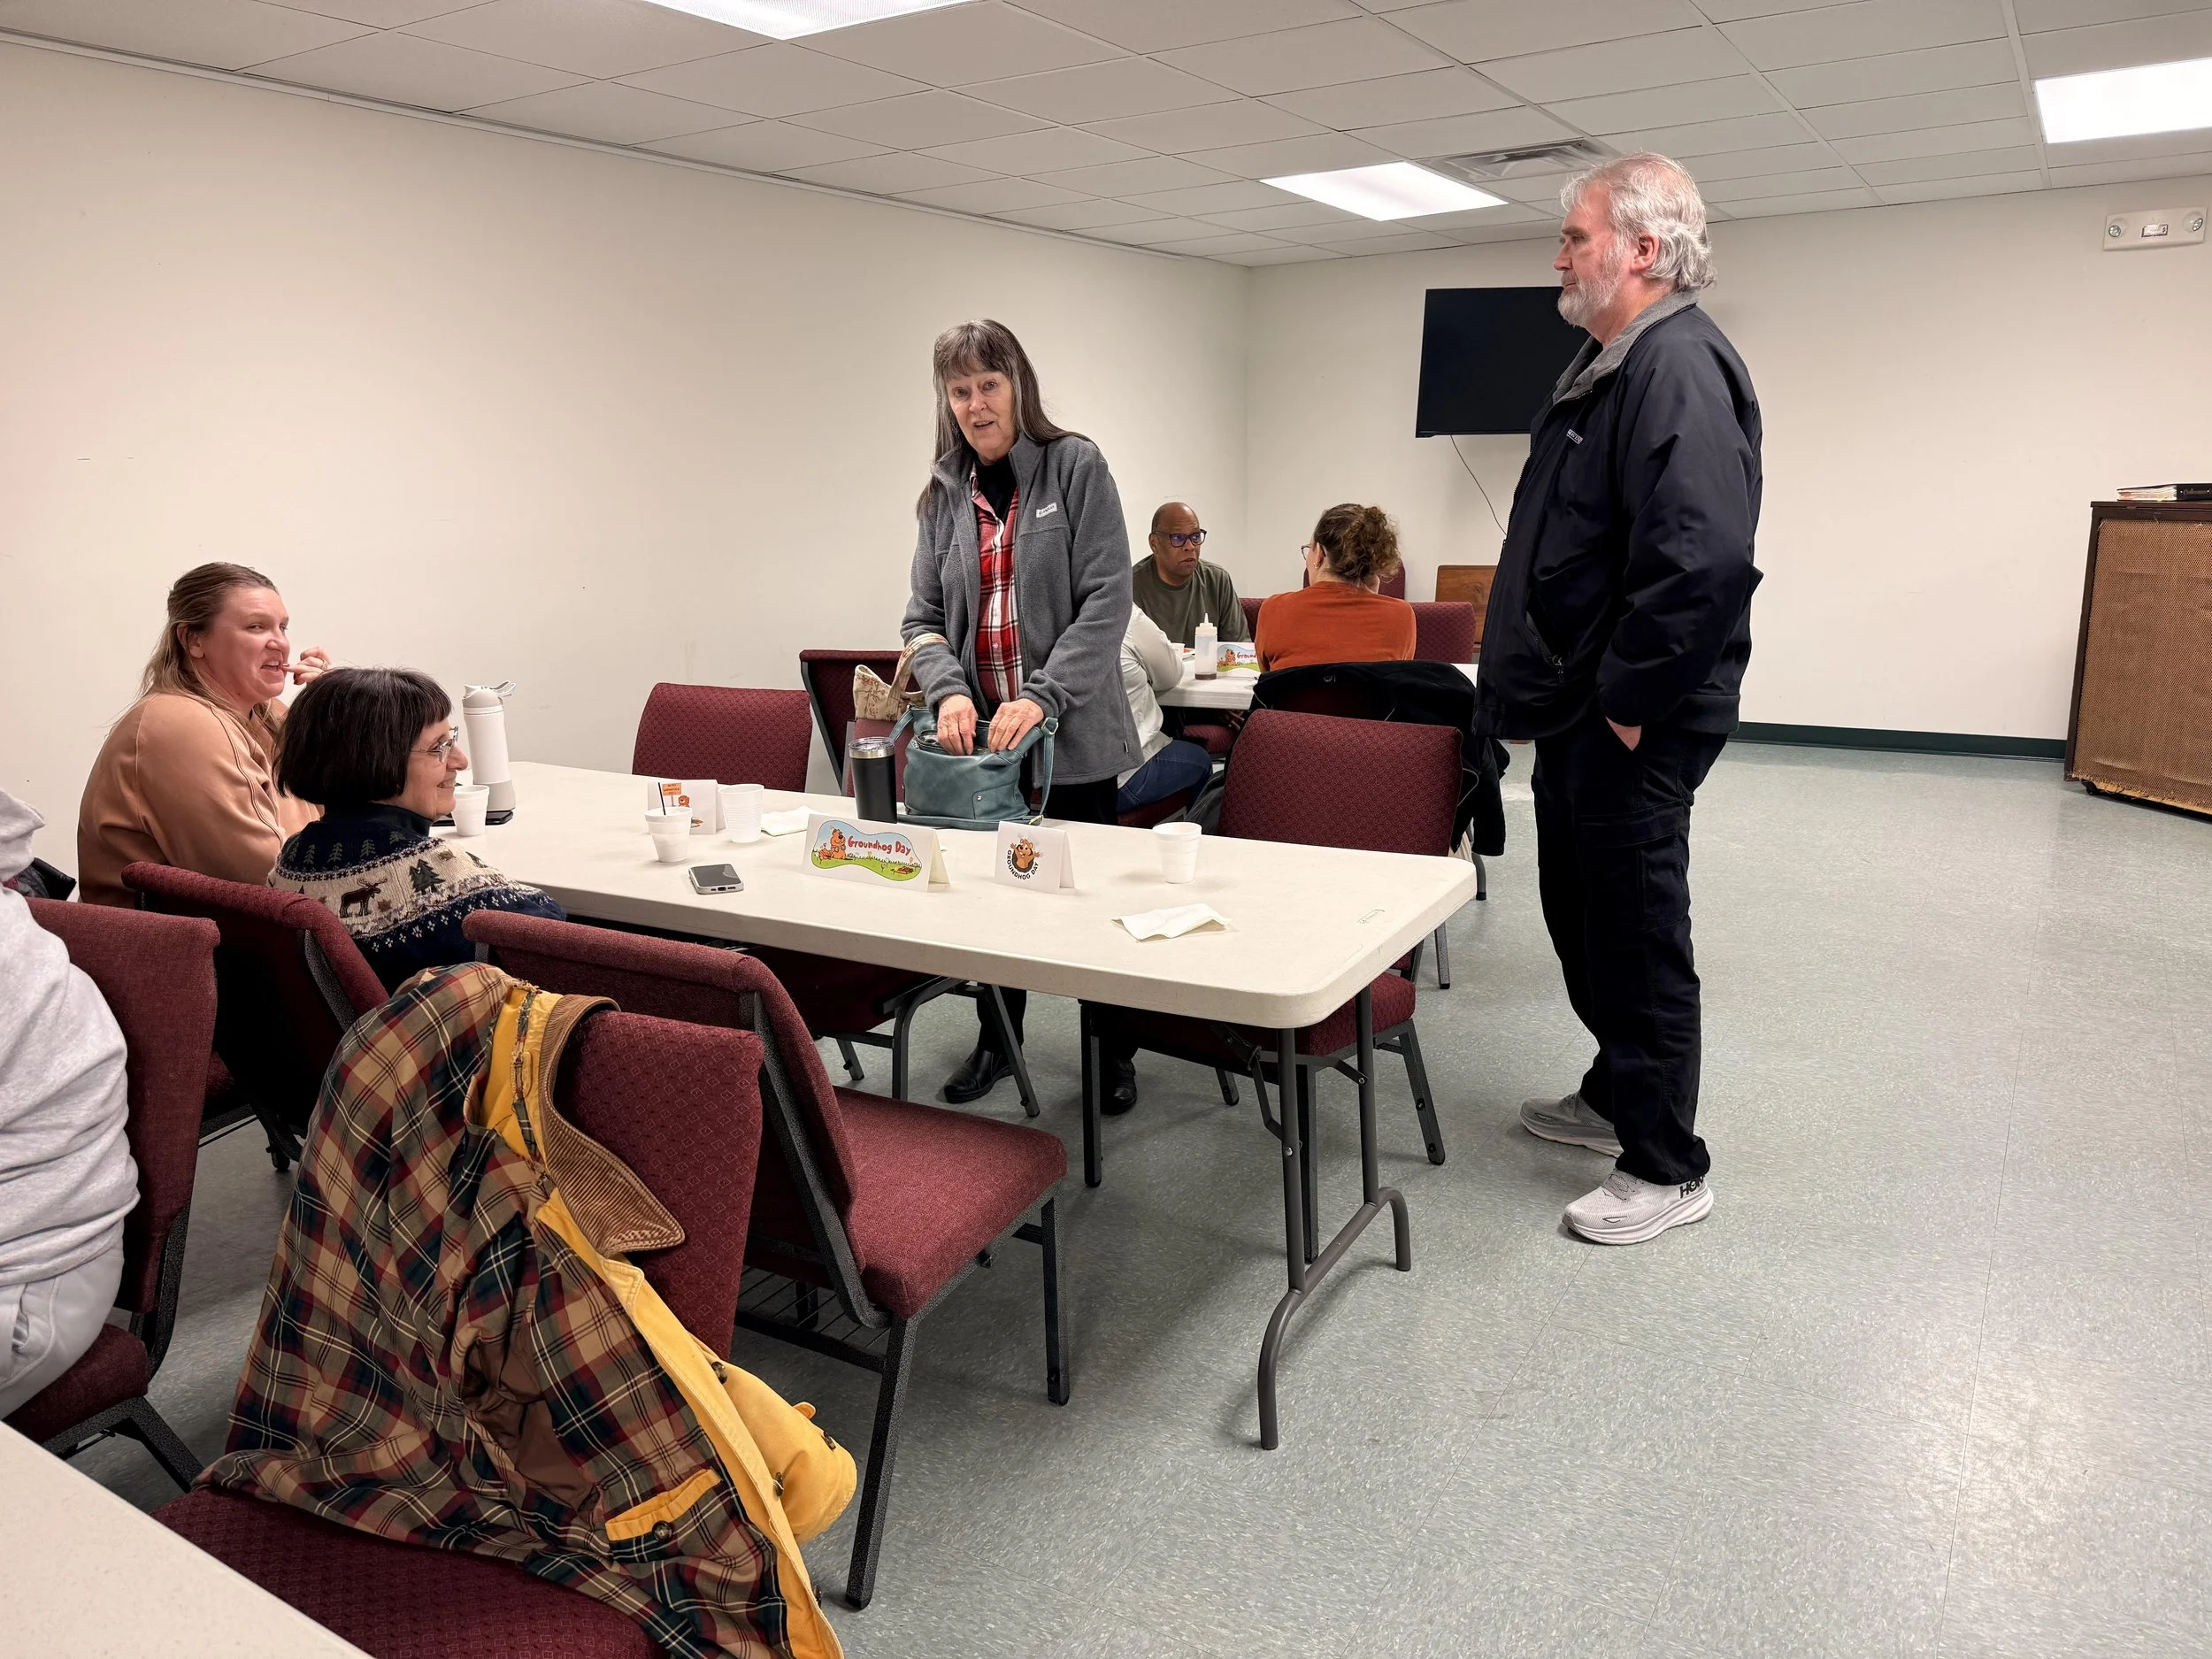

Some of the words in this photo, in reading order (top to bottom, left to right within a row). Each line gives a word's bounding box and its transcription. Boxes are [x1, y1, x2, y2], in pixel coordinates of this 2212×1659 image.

[848, 835, 893, 855] Groundhog
[895, 841, 911, 856] Day
[1006, 849, 1031, 880] GROUNDHOG
